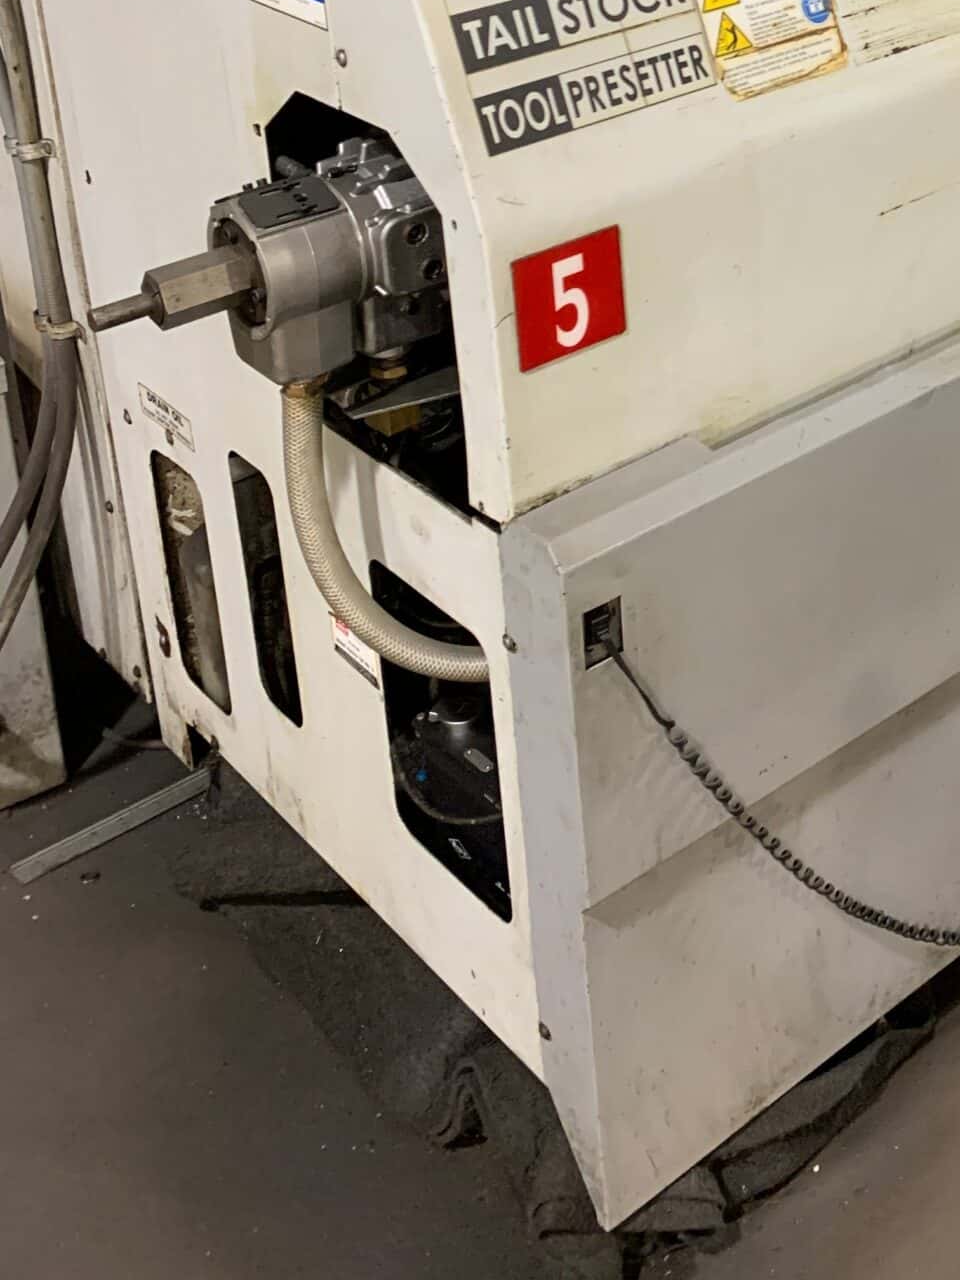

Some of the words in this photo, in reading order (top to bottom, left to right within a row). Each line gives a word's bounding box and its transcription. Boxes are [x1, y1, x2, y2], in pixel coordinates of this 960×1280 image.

[461, 6, 550, 60] TAIL
[481, 87, 569, 145] TOOL
[567, 45, 709, 118] PRESETTER
[552, 252, 590, 347] 5
